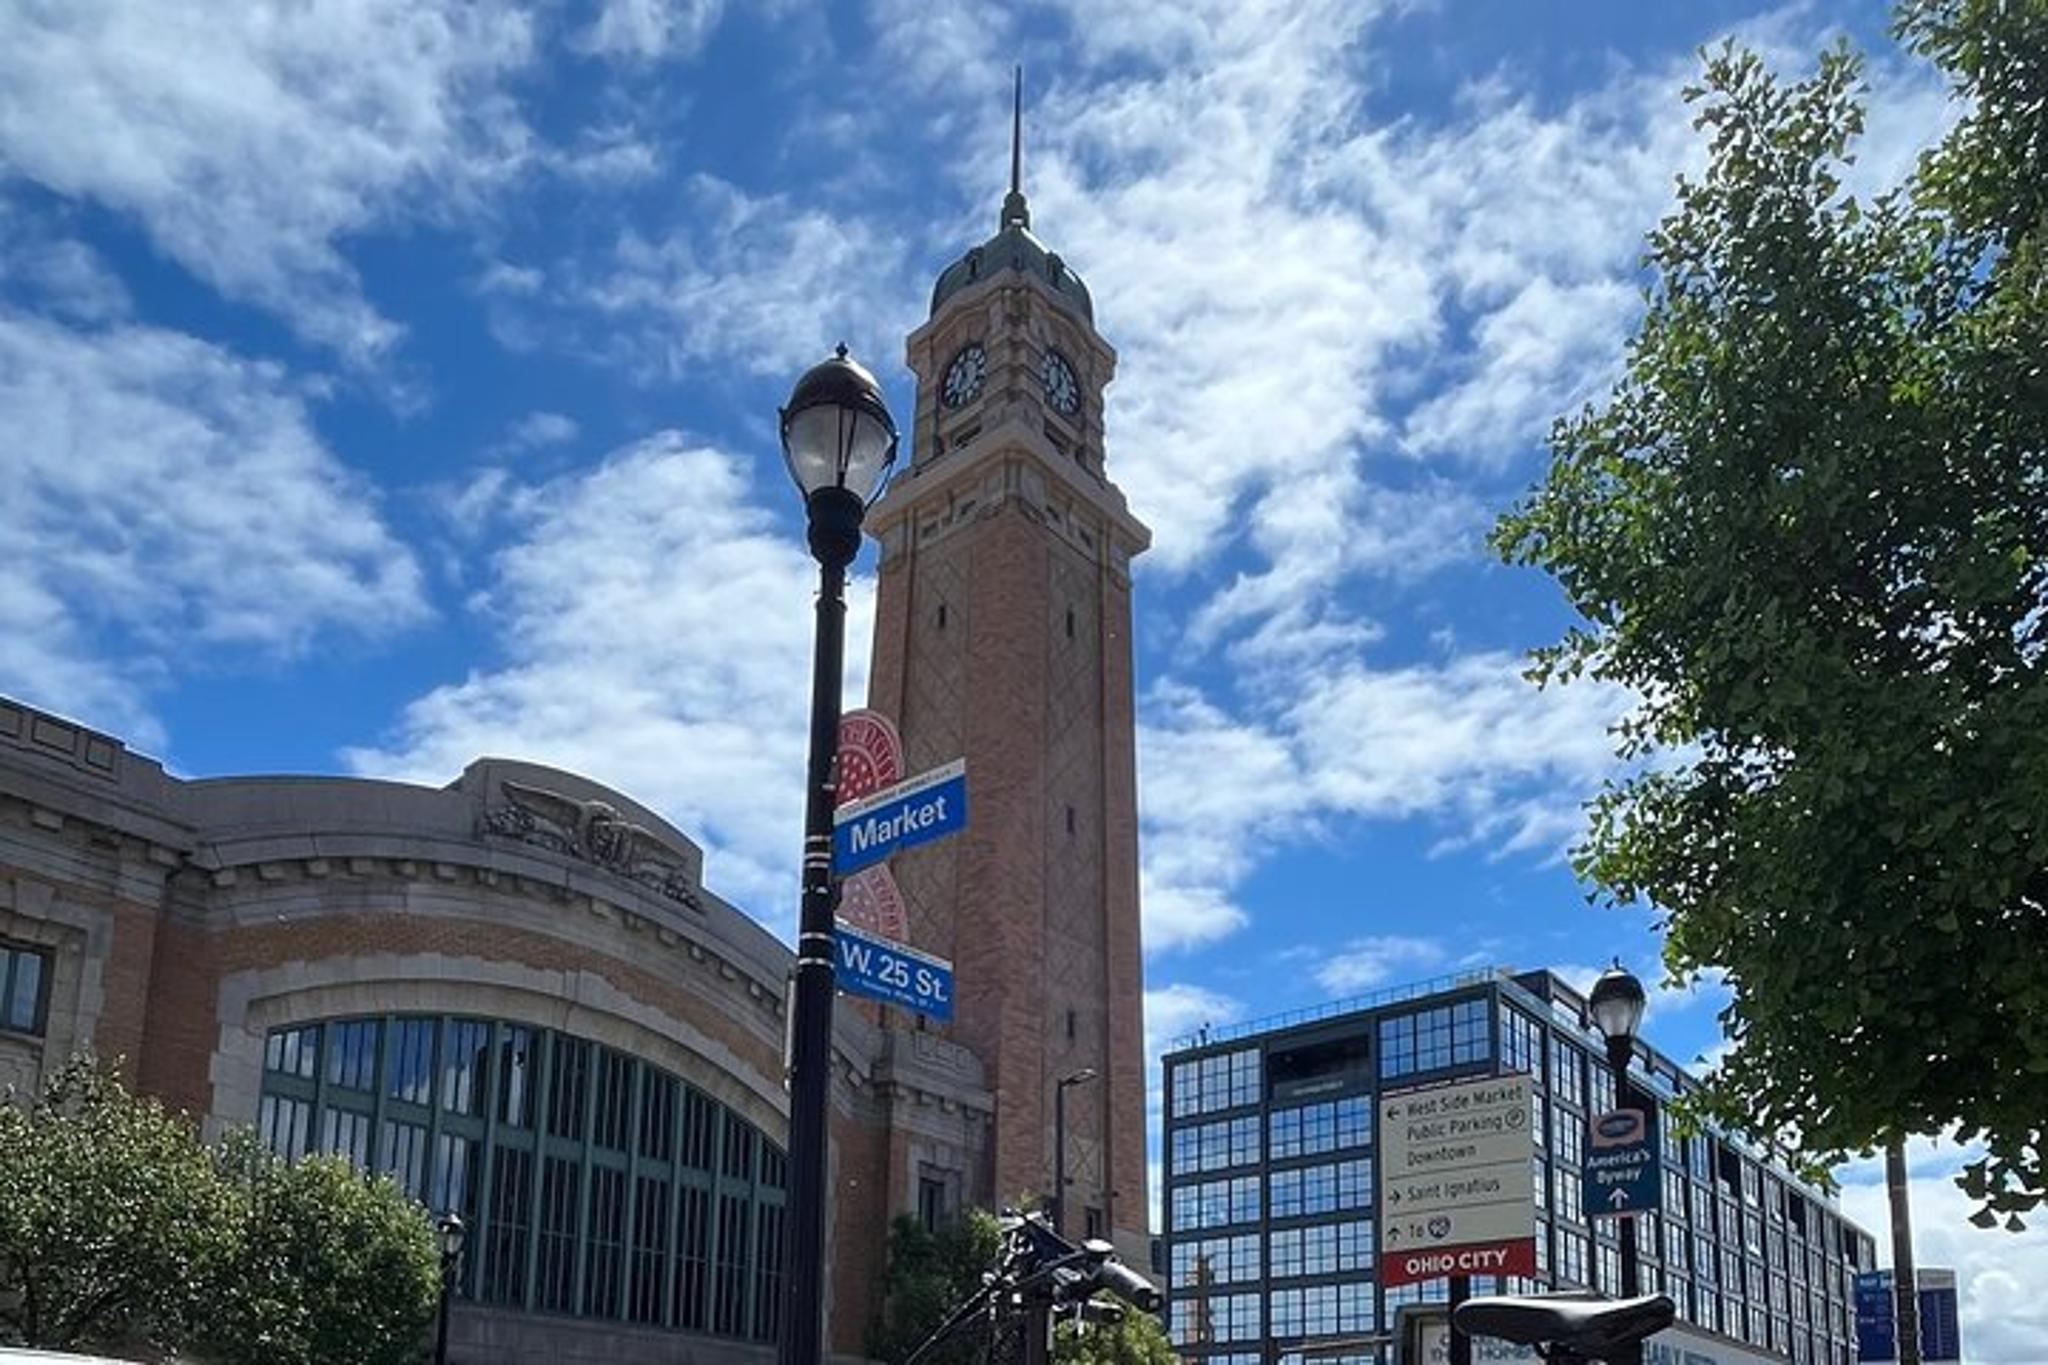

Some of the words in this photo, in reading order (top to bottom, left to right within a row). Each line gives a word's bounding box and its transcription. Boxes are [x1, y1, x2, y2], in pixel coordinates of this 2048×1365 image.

[850, 795, 947, 855] Market
[841, 940, 872, 977] W.
[878, 955, 909, 988] 25
[1407, 1100, 1437, 1117] West
[1440, 1094, 1469, 1112] Side
[1473, 1085, 1523, 1104] Market
[1407, 1122, 1446, 1140] Public
[1450, 1115, 1503, 1134] Parking
[1407, 1144, 1477, 1166] Downtown
[1407, 1184, 1440, 1201] Saint
[1444, 1178, 1501, 1199] Ignatius
[1405, 1254, 1454, 1275] OHIO
[1458, 1248, 1509, 1269] CITY
